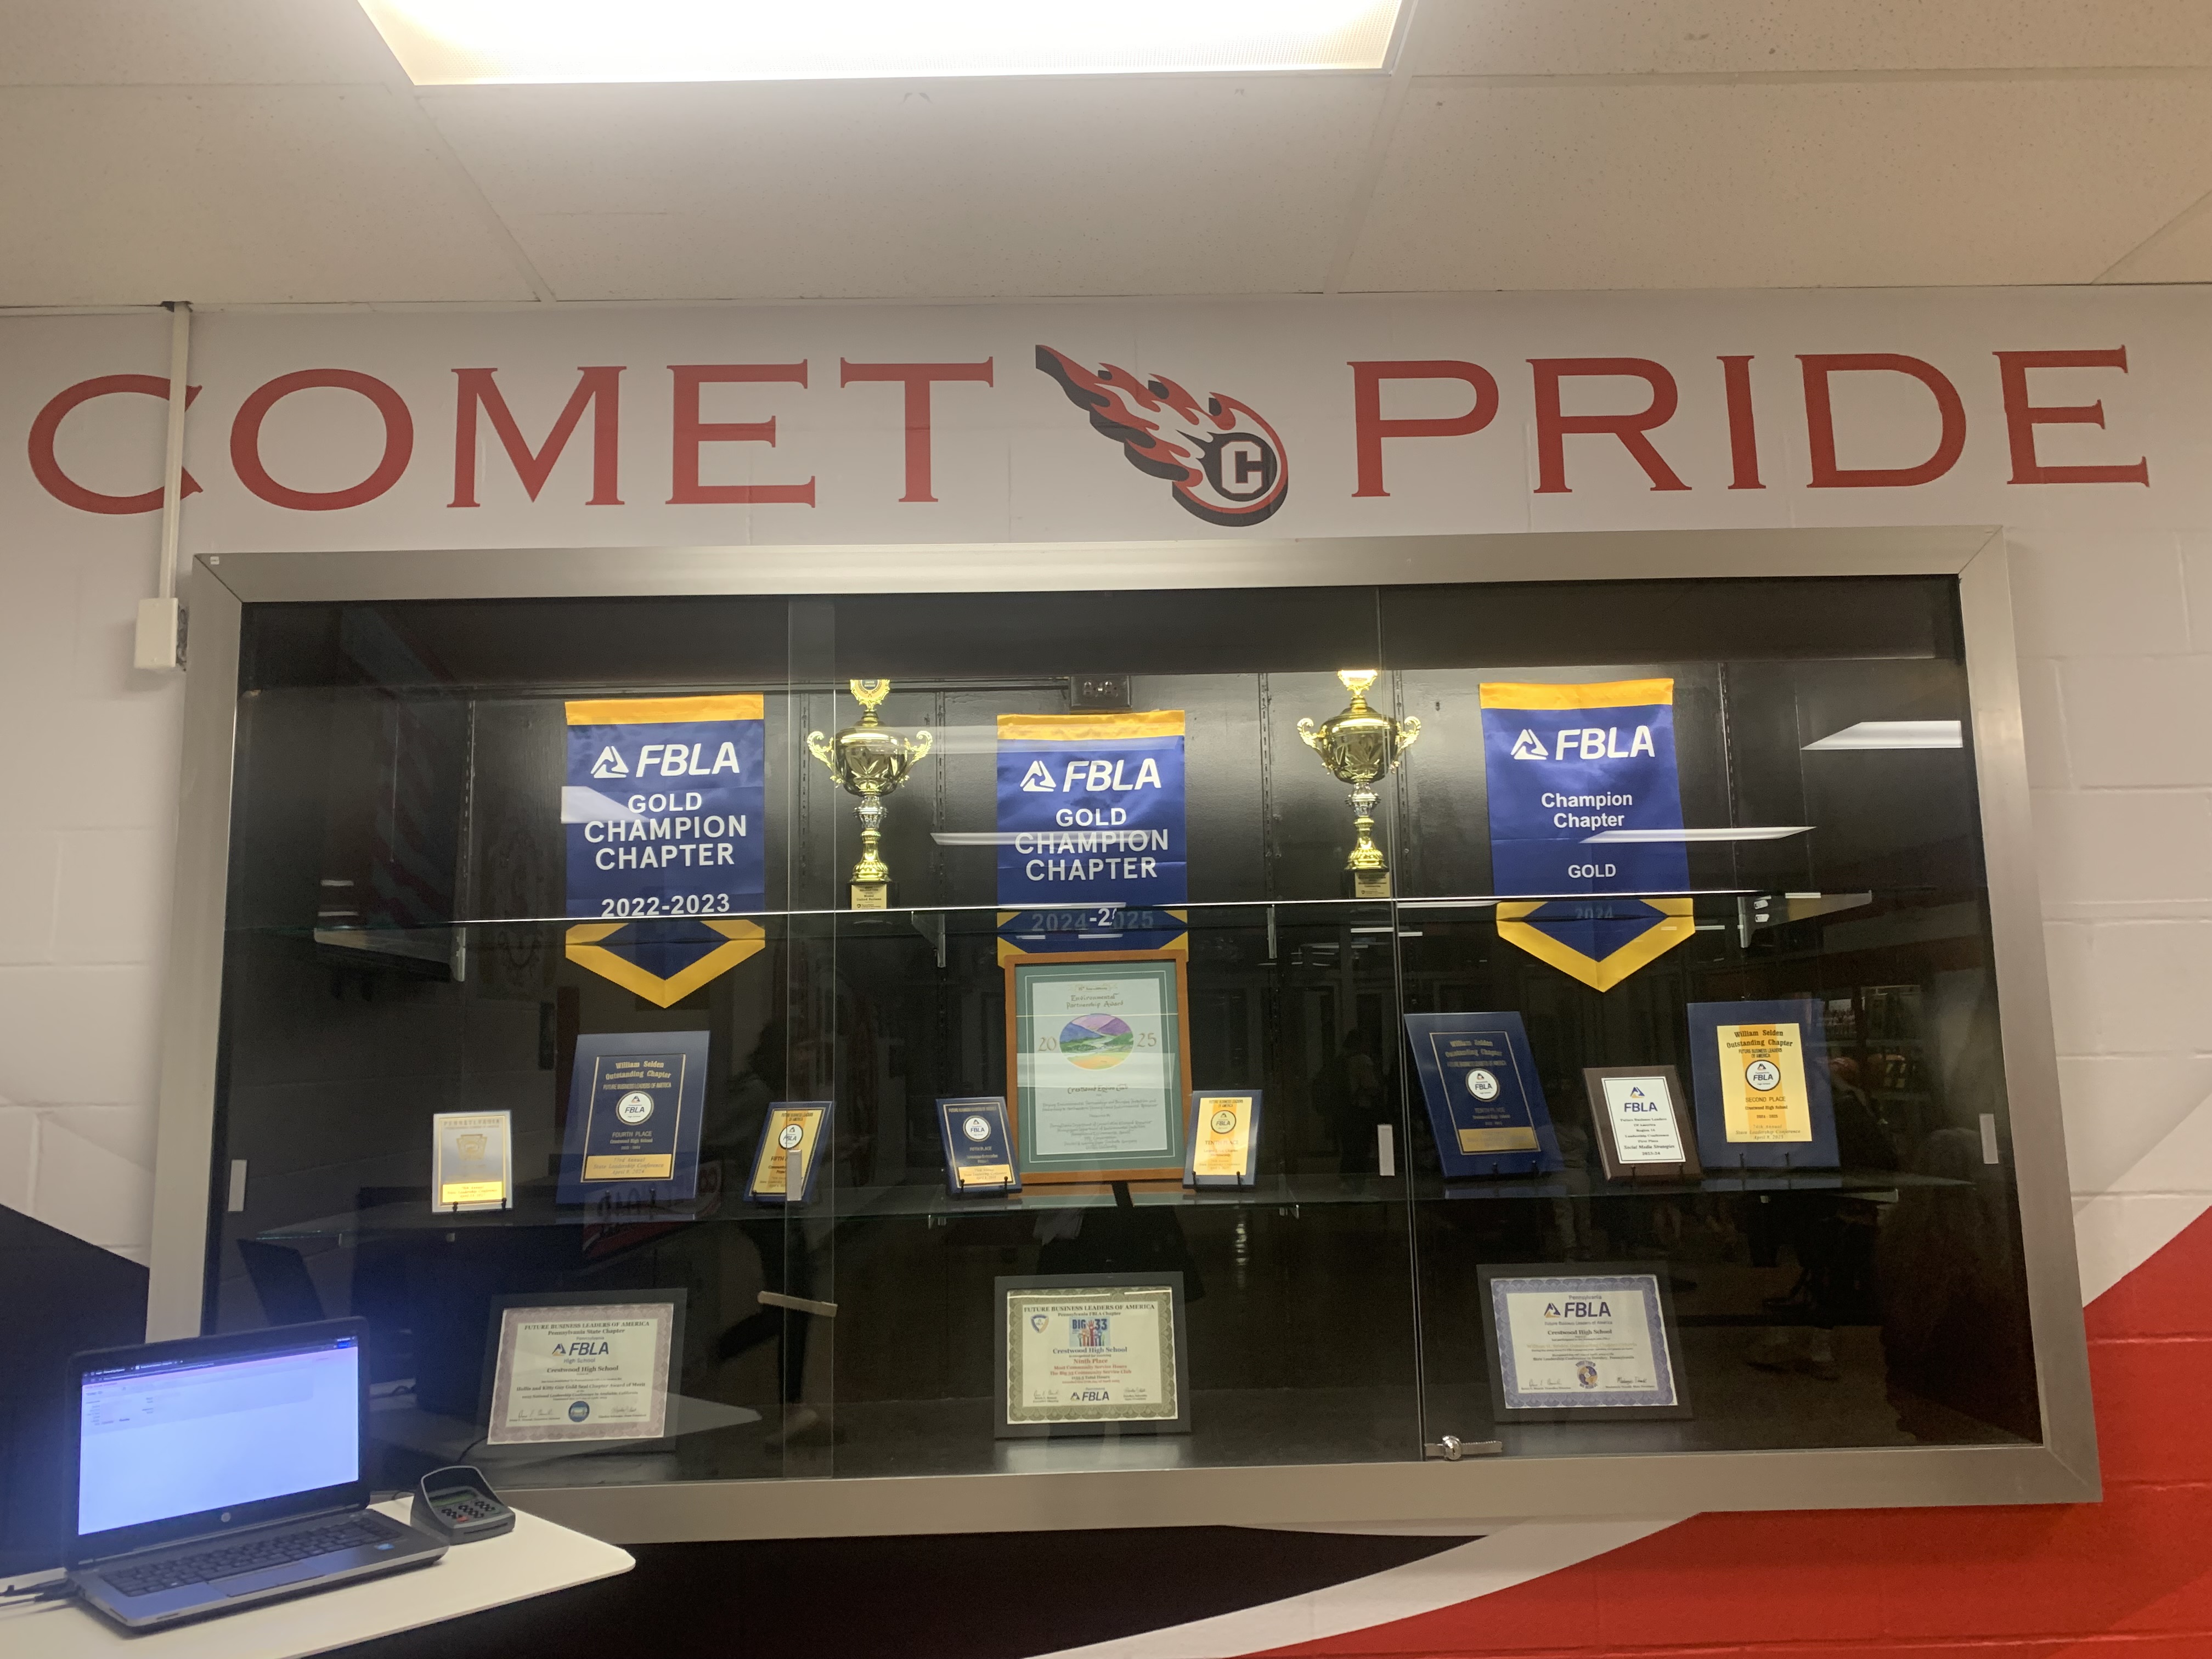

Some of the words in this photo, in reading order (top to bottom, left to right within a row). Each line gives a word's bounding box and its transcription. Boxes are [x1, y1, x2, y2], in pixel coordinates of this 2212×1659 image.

[28, 357, 994, 515] COMET
[1347, 344, 2149, 497] PRIDE
[1221, 441, 1263, 494] C
[1556, 725, 1655, 760] FBLA
[636, 742, 740, 778] FBLA
[1063, 759, 1162, 792] FBLA
[628, 792, 702, 813] GOLD
[1541, 792, 1633, 810] Champion
[1056, 808, 1127, 827] GOLD
[1553, 812, 1625, 831] Chapter
[584, 815, 746, 843] CHAMPION
[1015, 829, 1168, 854] CHAMPION
[595, 843, 735, 871] CHAPTER
[1026, 857, 1158, 881] CHAPTER
[1567, 864, 1616, 878] GOLD
[601, 893, 730, 917] 2022-2023
[1071, 992, 1120, 1002] Environmental
[1037, 1036, 1057, 1052] 20
[1137, 1032, 1158, 1048] 25
[1726, 1039, 1765, 1048] Outstanding
[615, 1061, 640, 1069] William
[605, 1070, 644, 1080] Outstanding
[647, 1070, 672, 1079] Chapter
[1624, 1102, 1658, 1113] FBLA
[1564, 1302, 1611, 1318] FBLA
[1072, 1319, 1086, 1329] BIG
[1094, 1318, 1108, 1331] 33
[568, 1341, 609, 1356] FBLA
[1082, 1391, 1109, 1401] FBLA
